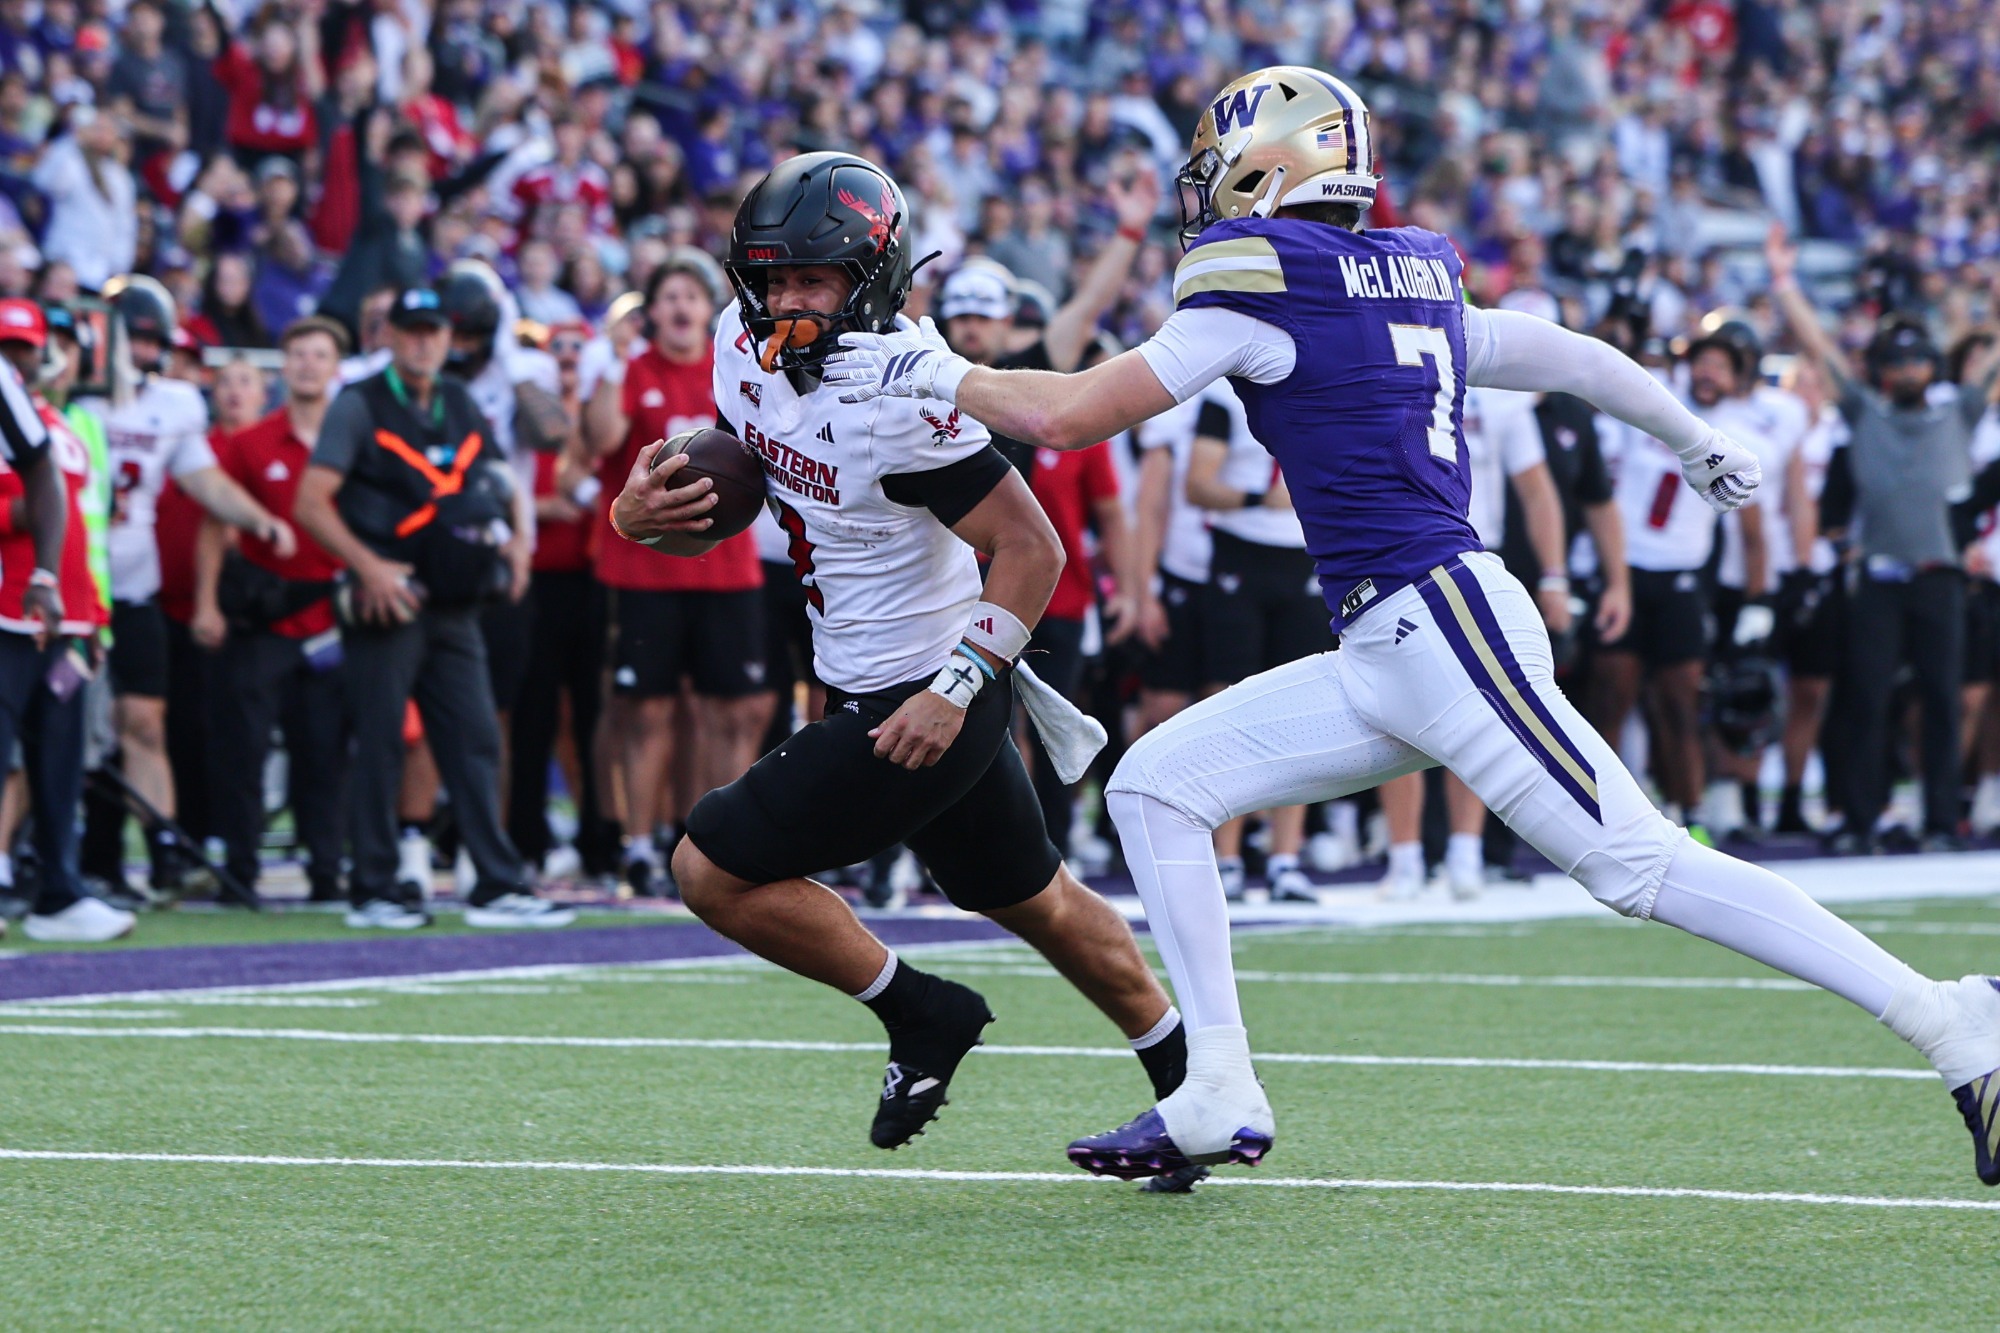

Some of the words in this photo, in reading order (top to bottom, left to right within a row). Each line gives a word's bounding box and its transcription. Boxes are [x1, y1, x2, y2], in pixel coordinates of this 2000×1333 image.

[1210, 83, 1273, 139] W
[747, 248, 777, 260] EWU
[1388, 322, 1458, 464] 7
[745, 420, 839, 488] EASTERN
[1705, 453, 1726, 470] W
